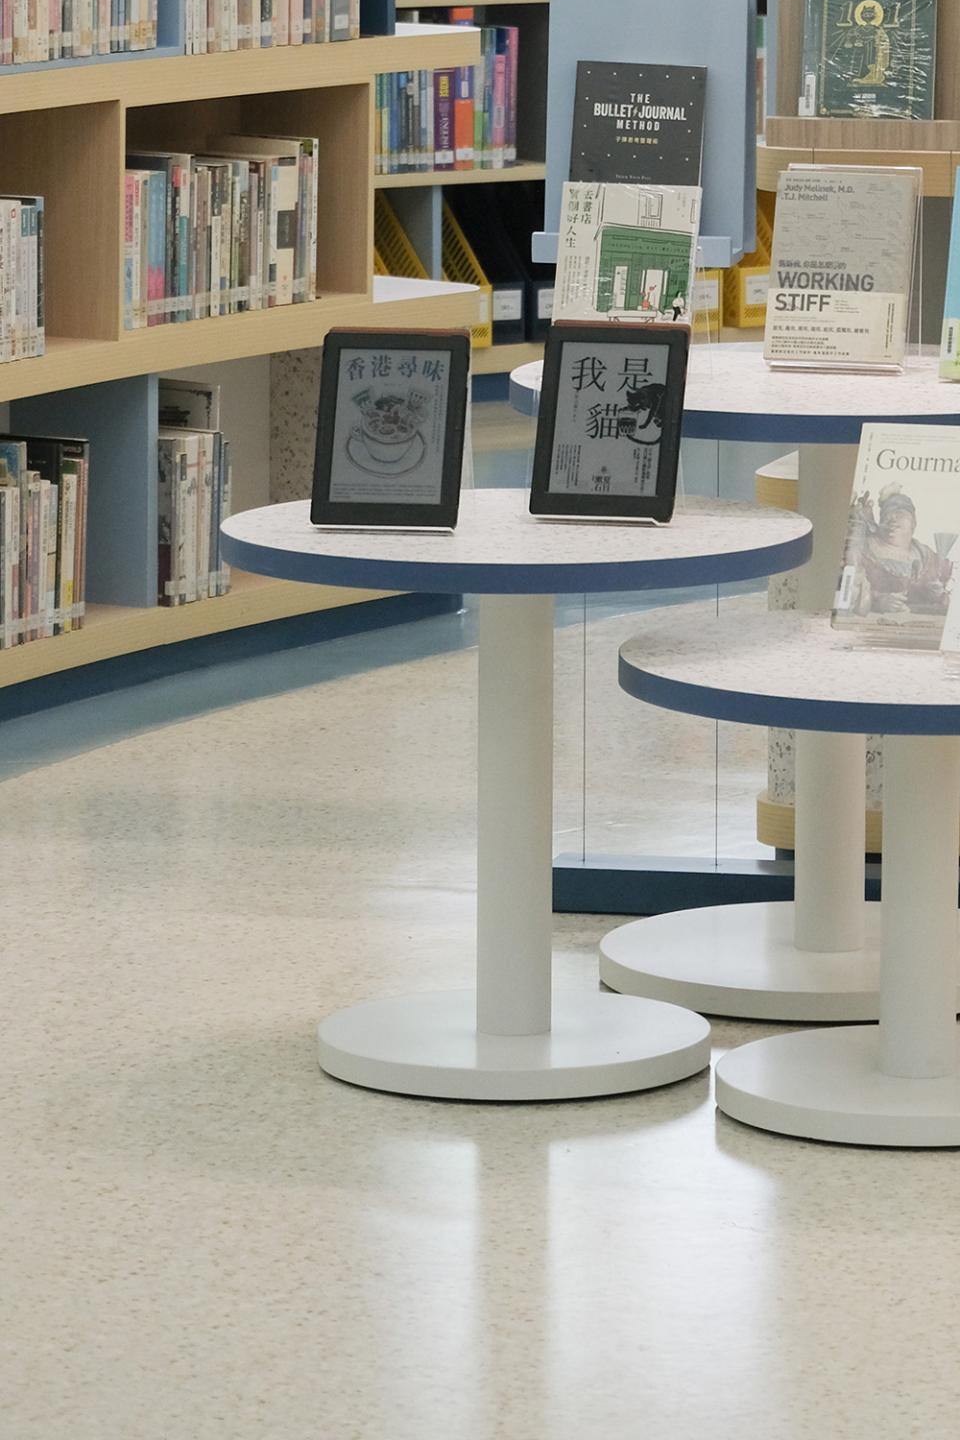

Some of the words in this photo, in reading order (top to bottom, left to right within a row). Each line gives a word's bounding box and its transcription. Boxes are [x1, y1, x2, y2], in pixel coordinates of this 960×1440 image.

[630, 93, 651, 104] THE
[594, 103, 634, 118] BULLET
[638, 107, 687, 121] JOURNAL
[616, 120, 661, 131] METHOD
[777, 271, 875, 292] WORKING
[775, 293, 832, 312] STIFF
[347, 355, 445, 382] 香港尋味
[571, 356, 653, 393] 我是
[585, 403, 621, 440] 貓
